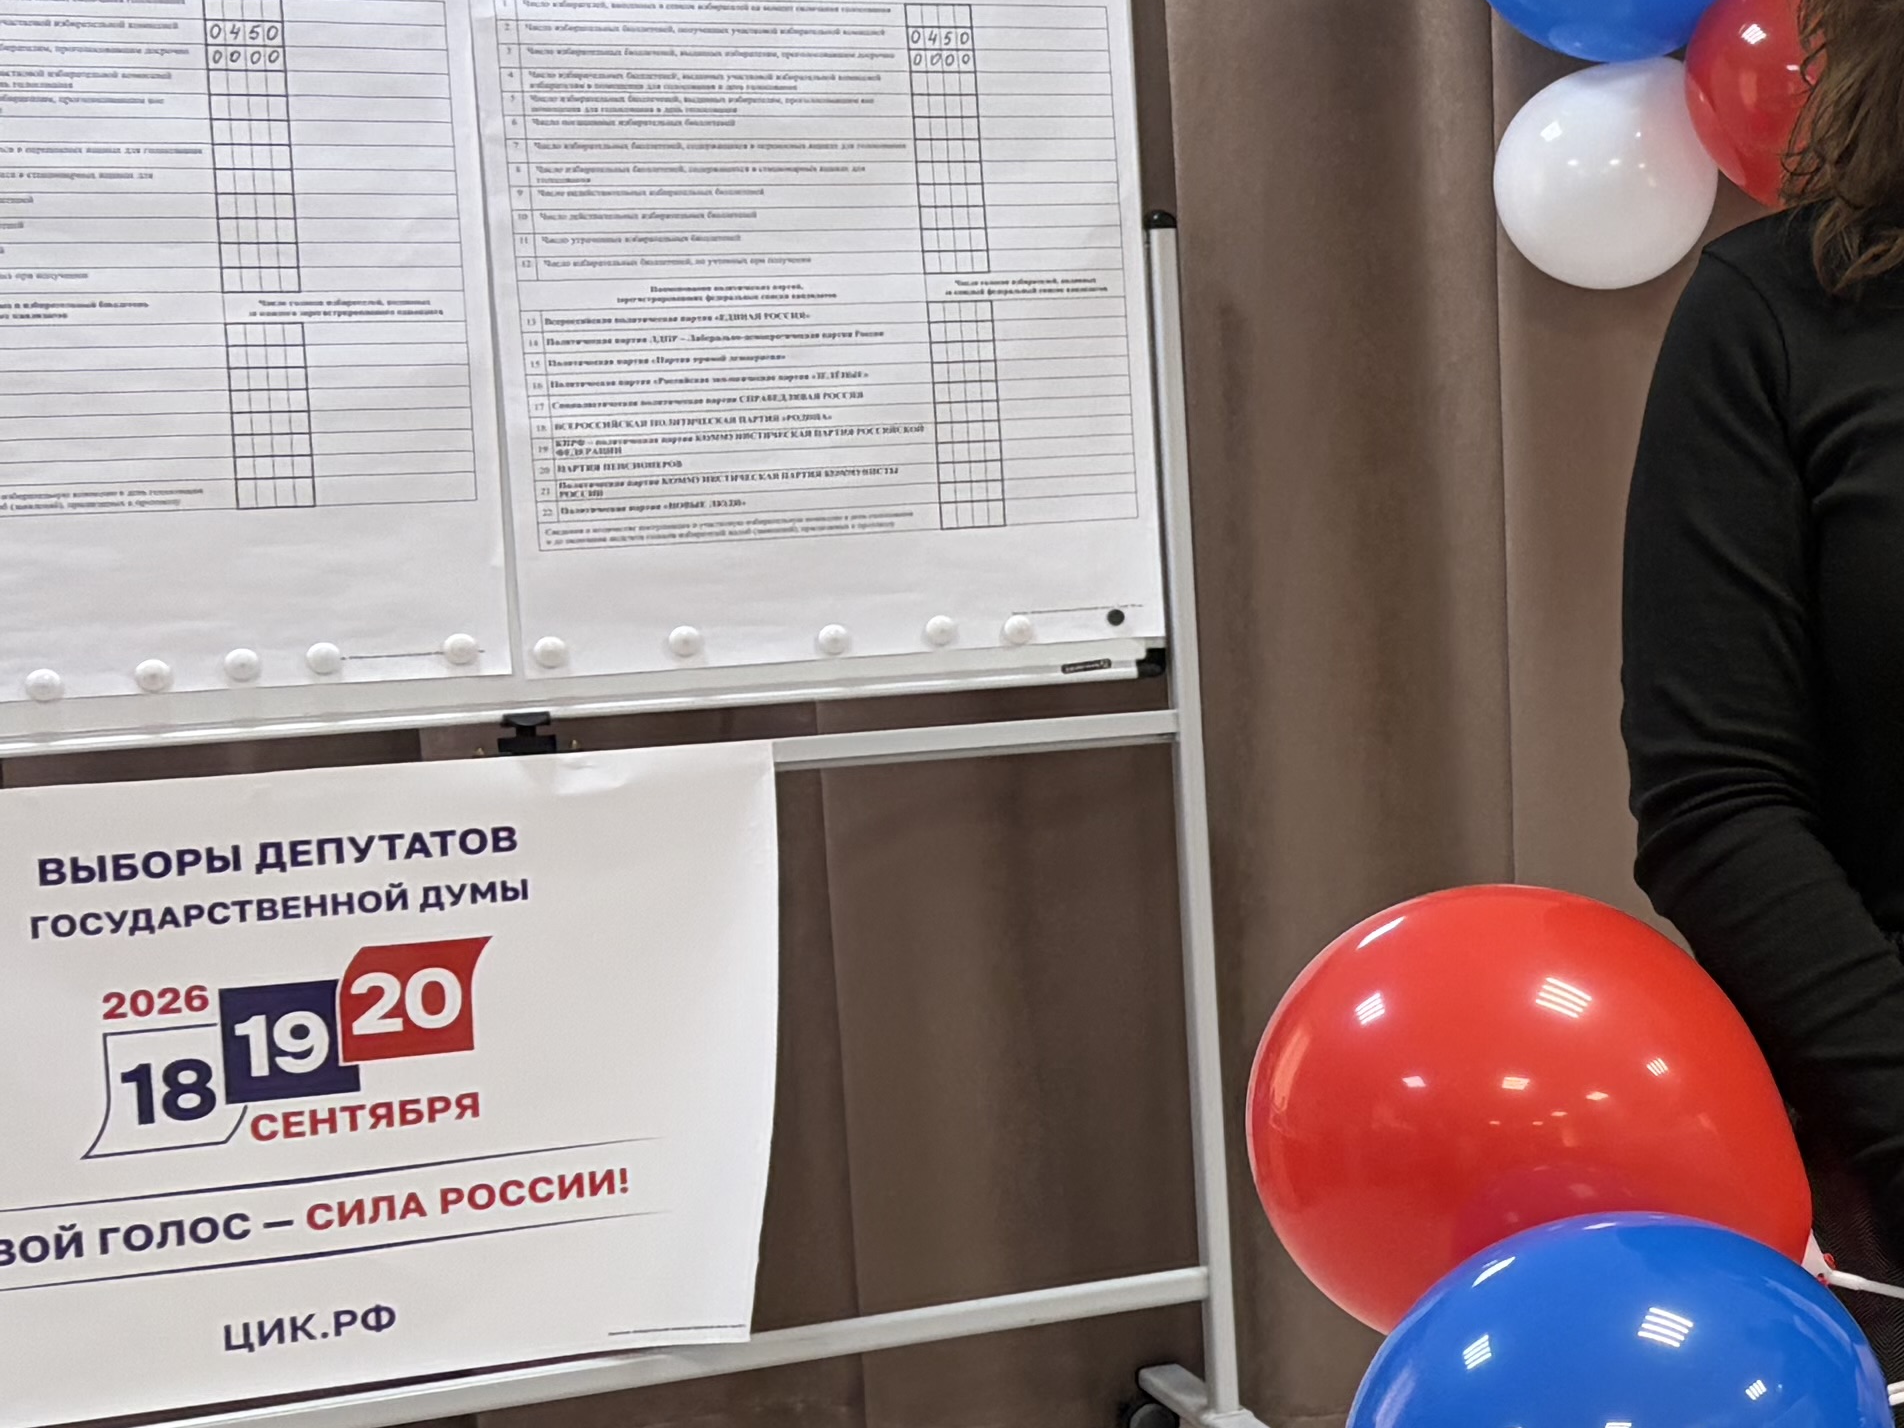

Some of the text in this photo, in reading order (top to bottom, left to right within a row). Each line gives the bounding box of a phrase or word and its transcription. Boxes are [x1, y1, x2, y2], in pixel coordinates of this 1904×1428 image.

[37, 826, 518, 887] ВЫБОРЫ ДЕПУТАТОВ
[30, 878, 529, 940] ГОСУДАРСТВЕННОЙ ДУМЫ
[102, 987, 210, 1019] 2026
[121, 967, 463, 1125] 18 19 20
[250, 1091, 480, 1143] СЕНТЯБРЯ
[98, 1211, 251, 1256] ГОЛОС
[306, 1192, 428, 1232] СИЛА
[440, 1169, 628, 1214] РОССИИ!
[223, 1304, 397, 1352] ЦИК.РФ
